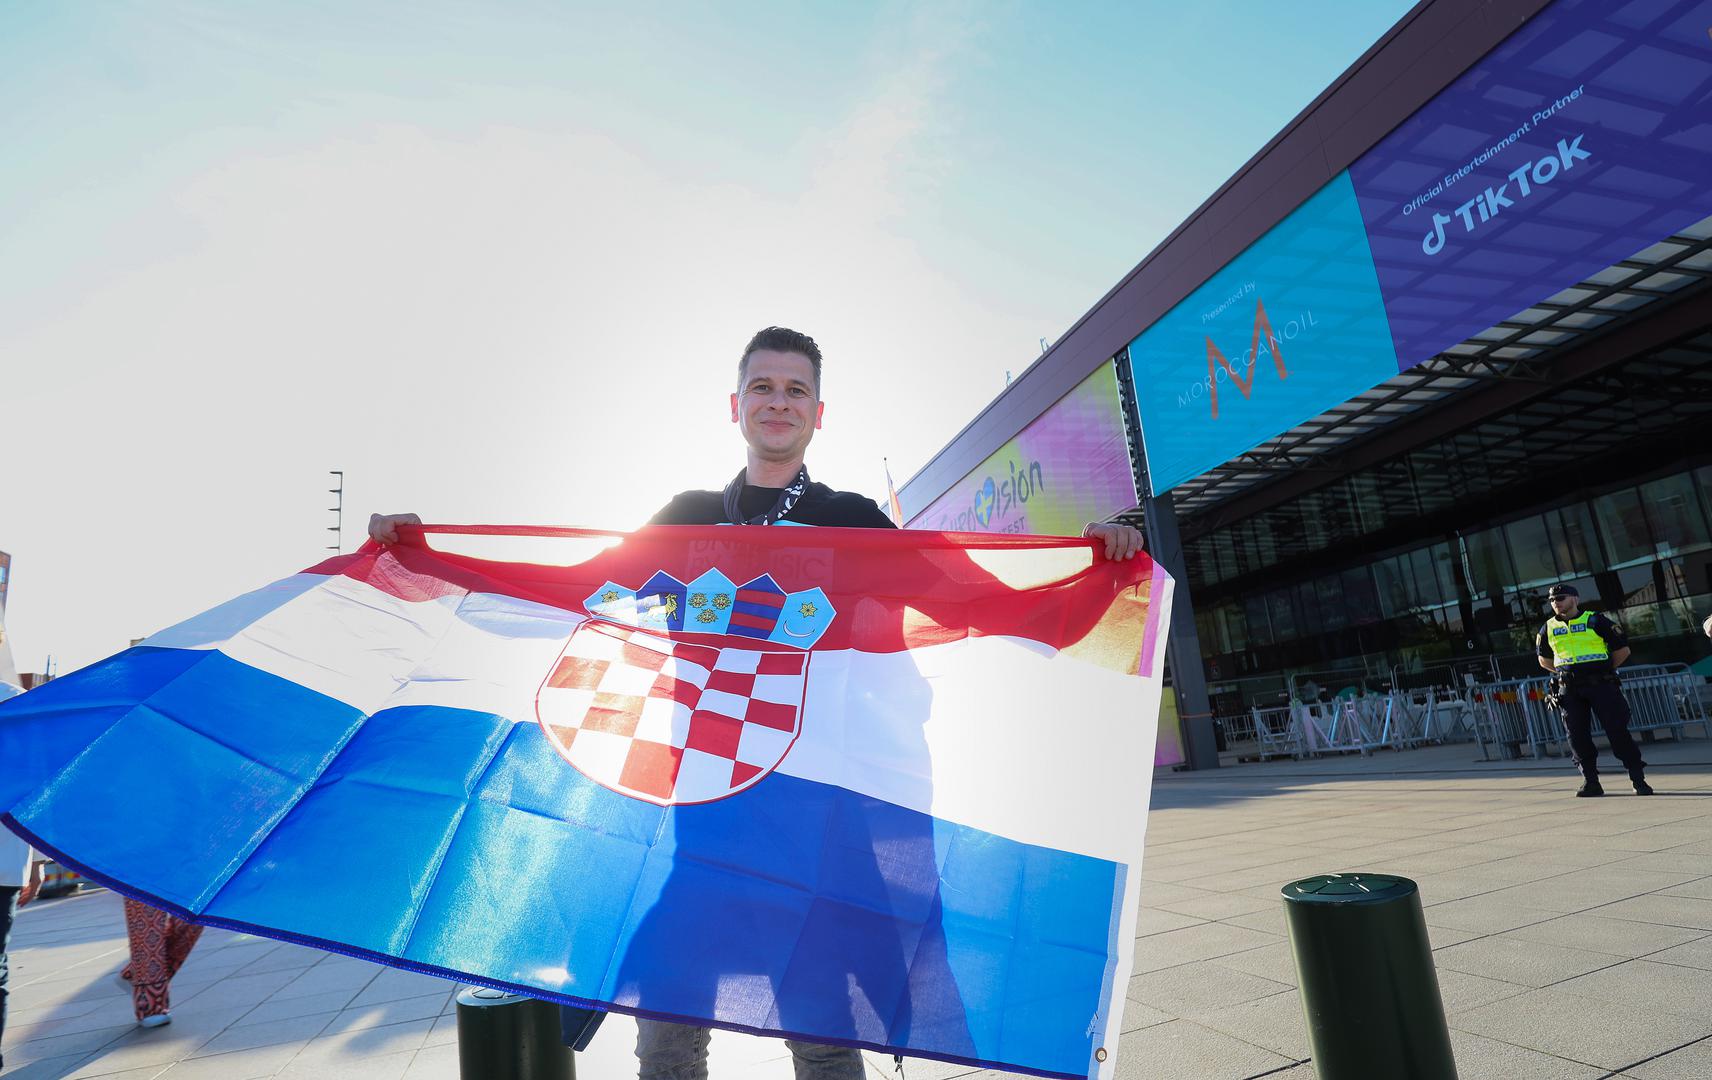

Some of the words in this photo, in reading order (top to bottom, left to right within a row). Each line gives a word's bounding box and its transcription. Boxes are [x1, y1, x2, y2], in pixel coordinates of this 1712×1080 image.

[1402, 178, 1443, 216] Official
[1444, 122, 1531, 187] Entertainment
[1532, 84, 1585, 126] Partner
[1454, 133, 1592, 233] TikTok
[1202, 290, 1244, 325] Presented
[1245, 280, 1256, 292] by
[1177, 309, 1319, 409] MOROCCANOIL
[1467, 639, 1474, 650] 6
[1553, 623, 1586, 636] POLIS
